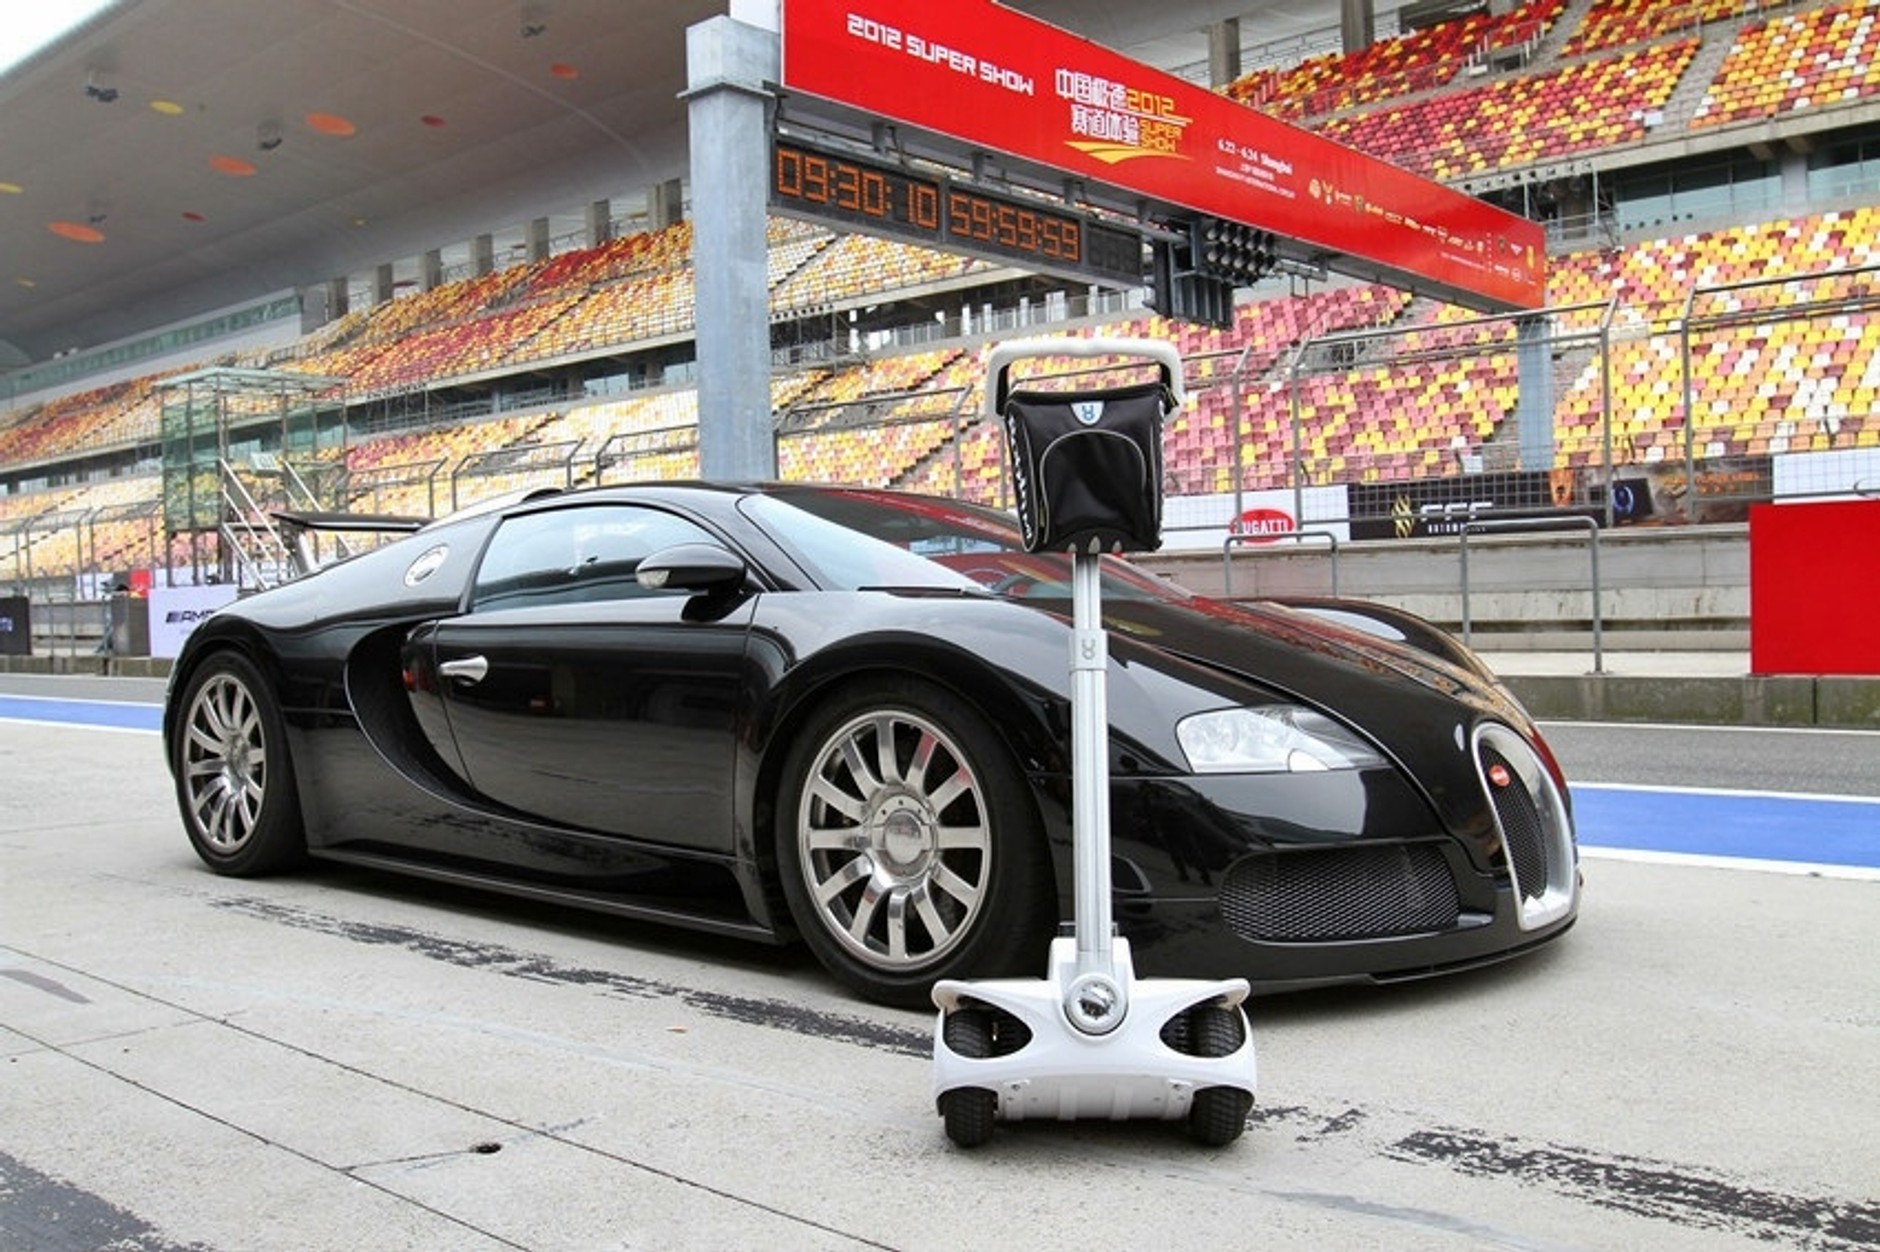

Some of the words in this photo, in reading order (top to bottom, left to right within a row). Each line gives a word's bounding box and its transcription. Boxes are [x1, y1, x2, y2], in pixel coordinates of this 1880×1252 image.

[847, 13, 902, 50] 2012
[906, 34, 977, 76] SUPER
[979, 60, 1035, 96] SHOW
[1126, 88, 1176, 118] 2012
[1140, 119, 1183, 141] SUPER
[1141, 134, 1176, 153] SHOW
[949, 193, 1080, 262] 59:59:59
[1234, 519, 1288, 536] UGATTI
